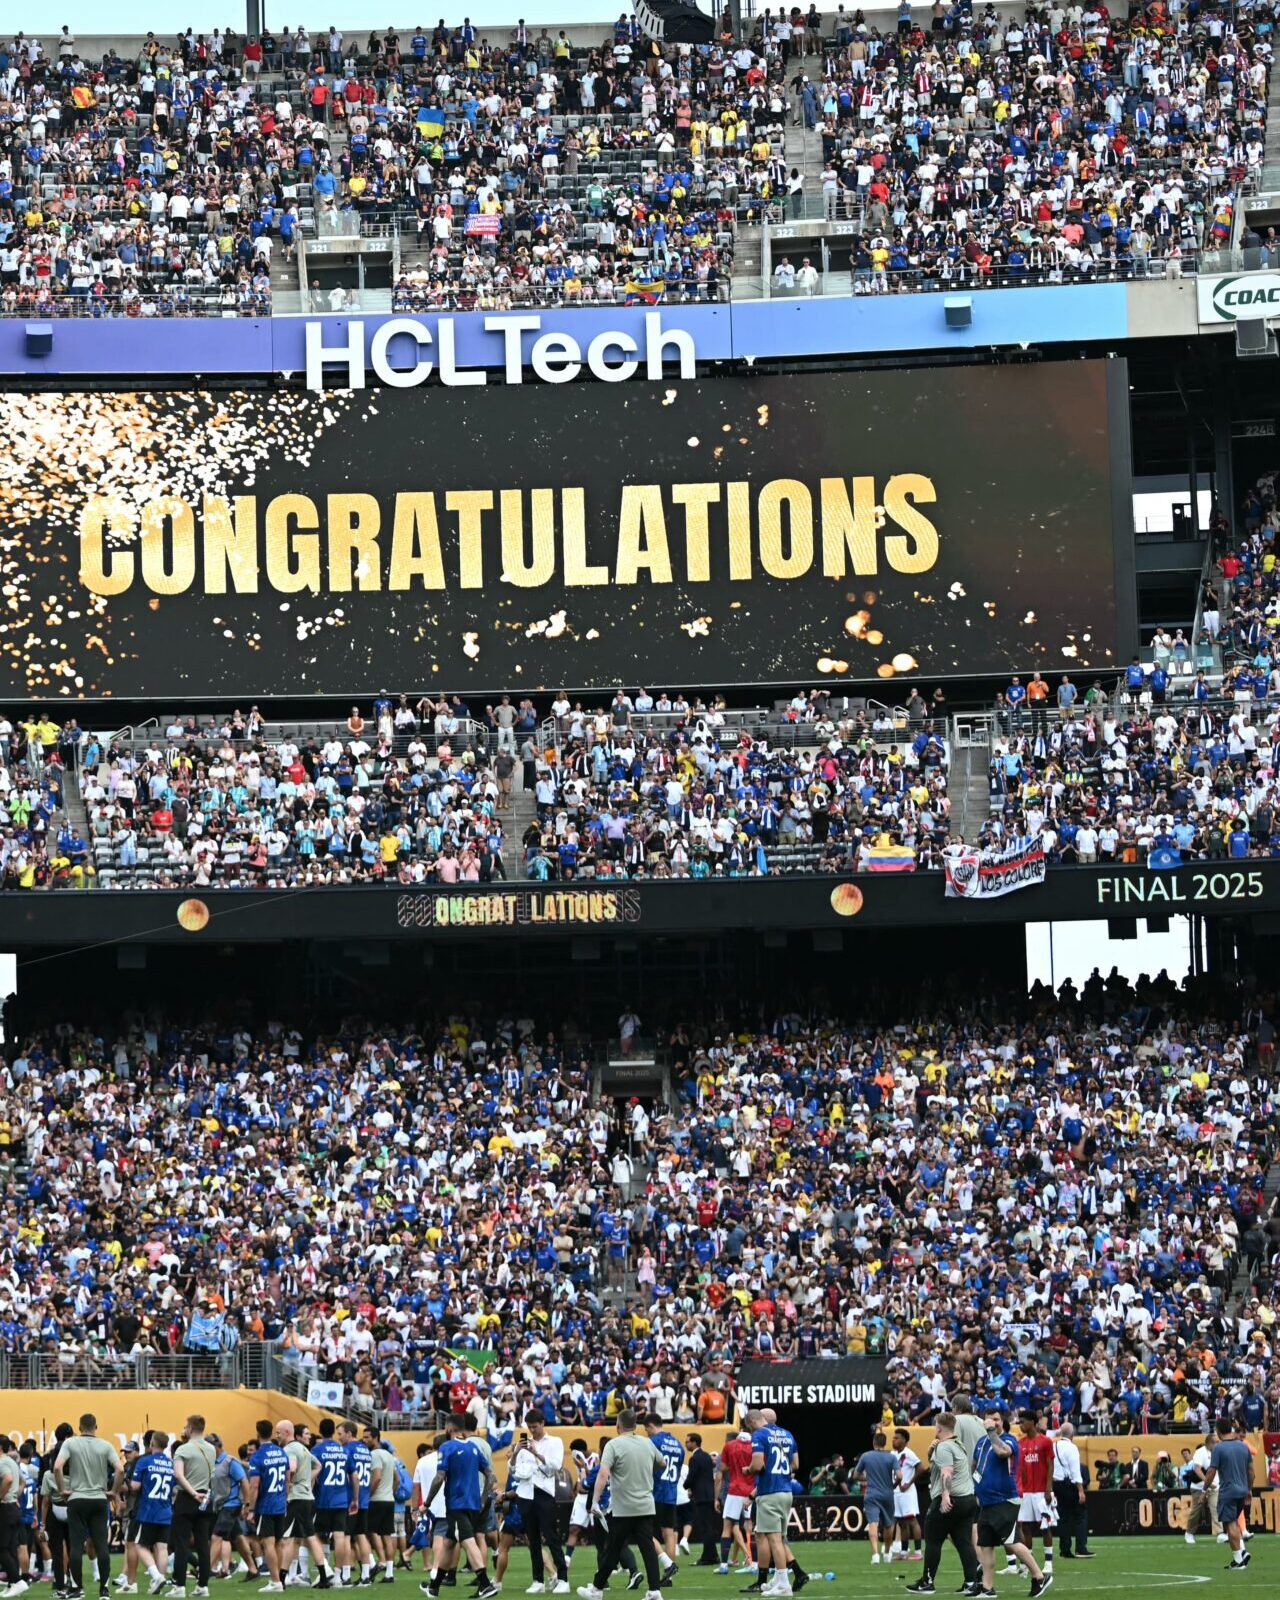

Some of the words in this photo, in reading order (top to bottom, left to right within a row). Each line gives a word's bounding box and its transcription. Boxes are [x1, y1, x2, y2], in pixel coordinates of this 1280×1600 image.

[304, 310, 697, 390] HCLTech
[80, 473, 940, 597] CONGRATULATIONS
[1097, 878, 1186, 903] FINAL
[1193, 872, 1264, 898] 2025
[737, 1385, 803, 1404] METLIFE
[807, 1383, 876, 1404] STADIUM
[154, 1458, 172, 1467] WORLD
[265, 1449, 282, 1457] WORLD
[355, 1446, 370, 1454] WORLD
[771, 1446, 790, 1475] 25
[148, 1465, 175, 1475] CHAMPION
[268, 1466, 286, 1493] 25
[324, 1461, 346, 1486] 25
[356, 1462, 370, 1487] 25
[660, 1455, 679, 1482] 25
[148, 1473, 171, 1500] 25
